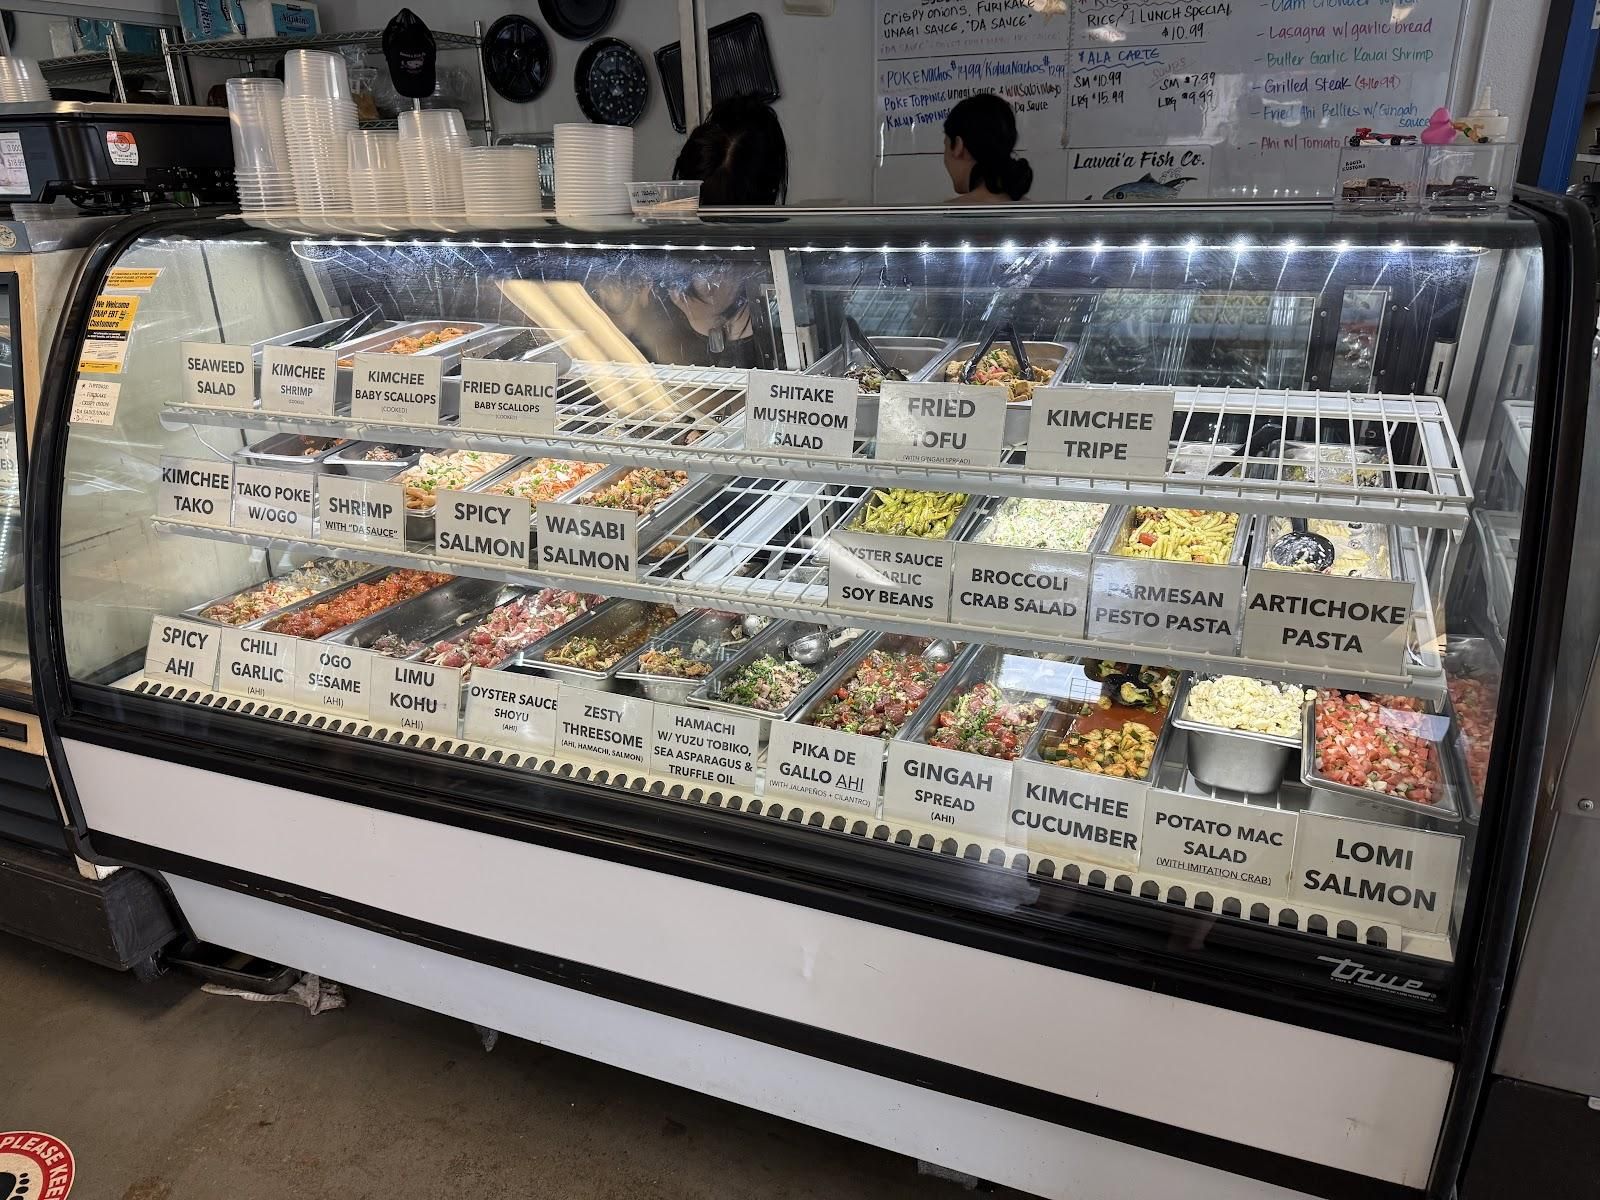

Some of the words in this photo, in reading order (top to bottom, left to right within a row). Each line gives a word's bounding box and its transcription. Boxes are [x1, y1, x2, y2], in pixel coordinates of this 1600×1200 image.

[1140, 7, 1181, 23] LUNCH
[1184, 3, 1232, 21] SPECIAL
[884, 26, 920, 39] UNAGI
[1161, 22, 1205, 41] $10.99
[1268, 25, 1325, 43] Lasagna
[1352, 22, 1391, 42] garlic
[1394, 18, 1432, 34] bread
[1088, 50, 1111, 64] ALA
[1118, 47, 1160, 61] CARTE
[1310, 50, 1346, 64] Garlic
[1391, 47, 1433, 64] Shrimp
[887, 70, 920, 88] POKE
[1074, 75, 1090, 88] SM
[1159, 78, 1179, 91] SM
[1264, 77, 1308, 94] Grilled
[1315, 77, 1352, 91] Steak
[1073, 151, 1136, 171] Lawai'a
[1140, 151, 1174, 169] Fish
[1180, 150, 1205, 168] Co.
[188, 357, 245, 374] SEAWEED
[272, 363, 326, 380] KIMCHEE
[197, 380, 236, 396] SALAD
[368, 370, 425, 385] KIMCHEE
[280, 384, 313, 397] SHRIMP
[355, 389, 383, 401] BABY
[384, 391, 436, 405] SCALLOPS
[463, 381, 501, 395] FRIED
[504, 383, 554, 398] GARLIC
[770, 384, 834, 404] SHITAKE
[474, 401, 496, 410] BABY
[497, 402, 540, 413] SCALLOPS
[908, 397, 976, 418] FRIED
[753, 406, 848, 430] MUSHROOM
[1046, 409, 1154, 431] KIMCHEE
[774, 431, 823, 450] SALAD
[1063, 440, 1128, 461] TRIPE
[162, 468, 230, 490] KIMCHEE
[237, 482, 271, 498] TAKO
[275, 486, 311, 503] POKE
[173, 496, 214, 515] TAKO
[248, 506, 297, 525] W/OGO
[329, 497, 393, 520] SHRIMP
[454, 502, 512, 525] SPICY
[325, 520, 347, 532] WITH
[545, 515, 625, 541] WASABI
[439, 531, 525, 559] SALMON
[543, 545, 630, 572] SALMON
[895, 552, 943, 568] SAUCE
[971, 567, 1068, 592] BROCCOLI
[842, 586, 876, 602] SOY
[879, 590, 934, 609] BEANS
[960, 591, 1009, 610] CRAB
[1014, 597, 1077, 617] SALAD
[1248, 592, 1406, 625] ARTICHOKE
[1095, 606, 1160, 628] PESTO
[1165, 614, 1232, 635] PASTA
[162, 626, 208, 650] SPICY
[240, 637, 278, 657] CHILI
[1281, 627, 1363, 653] PASTA
[165, 657, 194, 678] AHI
[319, 653, 352, 669] OGO
[231, 661, 284, 683] GARLIC
[395, 667, 435, 687] LIMU
[247, 686, 265, 697] (AHI)
[308, 673, 361, 693] SESAME
[323, 696, 344, 708] (AHI)
[390, 692, 437, 714] KOHU
[471, 686, 516, 704] OYSTER
[518, 694, 557, 711] SAUCE
[401, 718, 424, 731] (AHI)
[494, 708, 529, 722] SHOYU
[584, 705, 623, 723] ZESTY
[502, 723, 518, 733] (AHI)
[563, 722, 643, 749] THREESOME
[675, 716, 736, 736] HAMACHI
[657, 730, 673, 742] W/
[674, 733, 704, 747] YUZU
[611, 750, 644, 763] SALMON)
[654, 746, 674, 757] SEA
[675, 750, 742, 770] ASPARAGUS
[745, 762, 753, 772] &
[792, 741, 830, 761] PIKA
[833, 749, 856, 766] DE
[669, 764, 714, 782] TRUFFLE
[716, 773, 736, 785] OIL
[779, 762, 833, 784] GALLO
[835, 773, 864, 793] AHI
[903, 759, 993, 793] GINGAH
[769, 779, 789, 790] (WITH
[834, 793, 871, 808] CILANTRO)
[914, 789, 975, 812] SPREAD
[1026, 782, 1129, 819] KIMCHEE
[930, 811, 955, 825] (AHI)
[1011, 808, 1138, 851] CUCUMBER
[1155, 811, 1232, 838] POTATO
[1237, 826, 1284, 847] MAC
[1183, 841, 1248, 864] SALAD
[1335, 838, 1414, 871] LOMI
[1156, 856, 1185, 870] (WITH
[1186, 861, 1238, 880] IMITATION
[1240, 872, 1272, 887] CRAB)
[1303, 869, 1437, 912] SALMON
[1317, 956, 1431, 998] true
[0, 1135, 65, 1166] PLEASE
[43, 1163, 68, 1200] KEE
